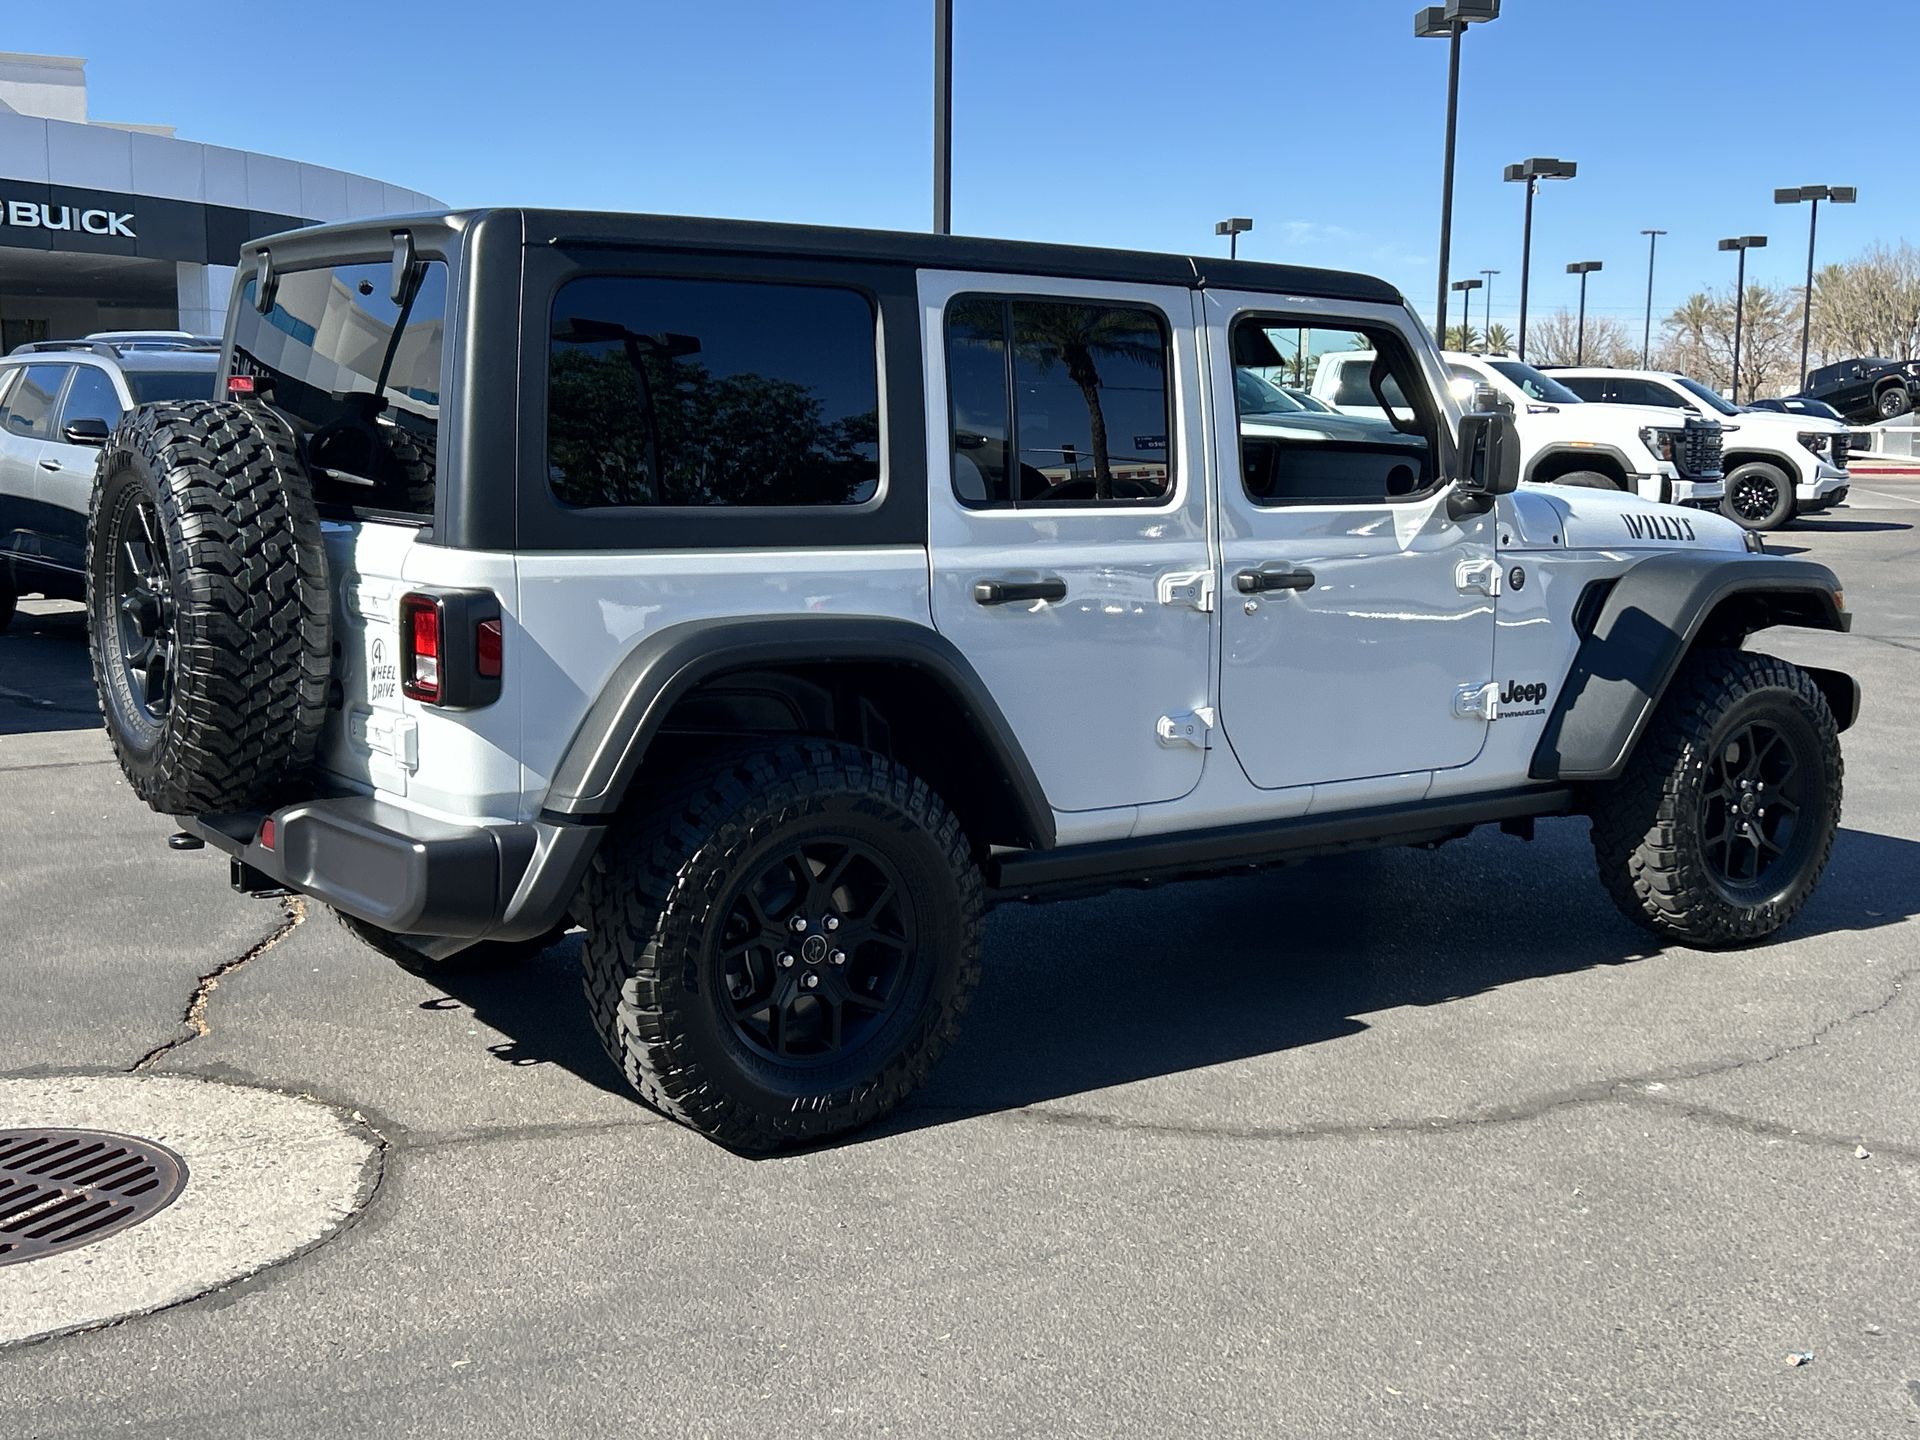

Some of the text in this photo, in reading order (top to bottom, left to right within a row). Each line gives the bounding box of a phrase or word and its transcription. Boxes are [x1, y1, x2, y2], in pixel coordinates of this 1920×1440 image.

[8, 200, 137, 238] BUICK
[1620, 513, 1696, 541] WILLYS
[371, 665, 396, 682] WHEEL
[372, 683, 396, 701] DRIVE
[1500, 680, 1547, 705] Jeep
[1504, 708, 1546, 718] WRANGLER
